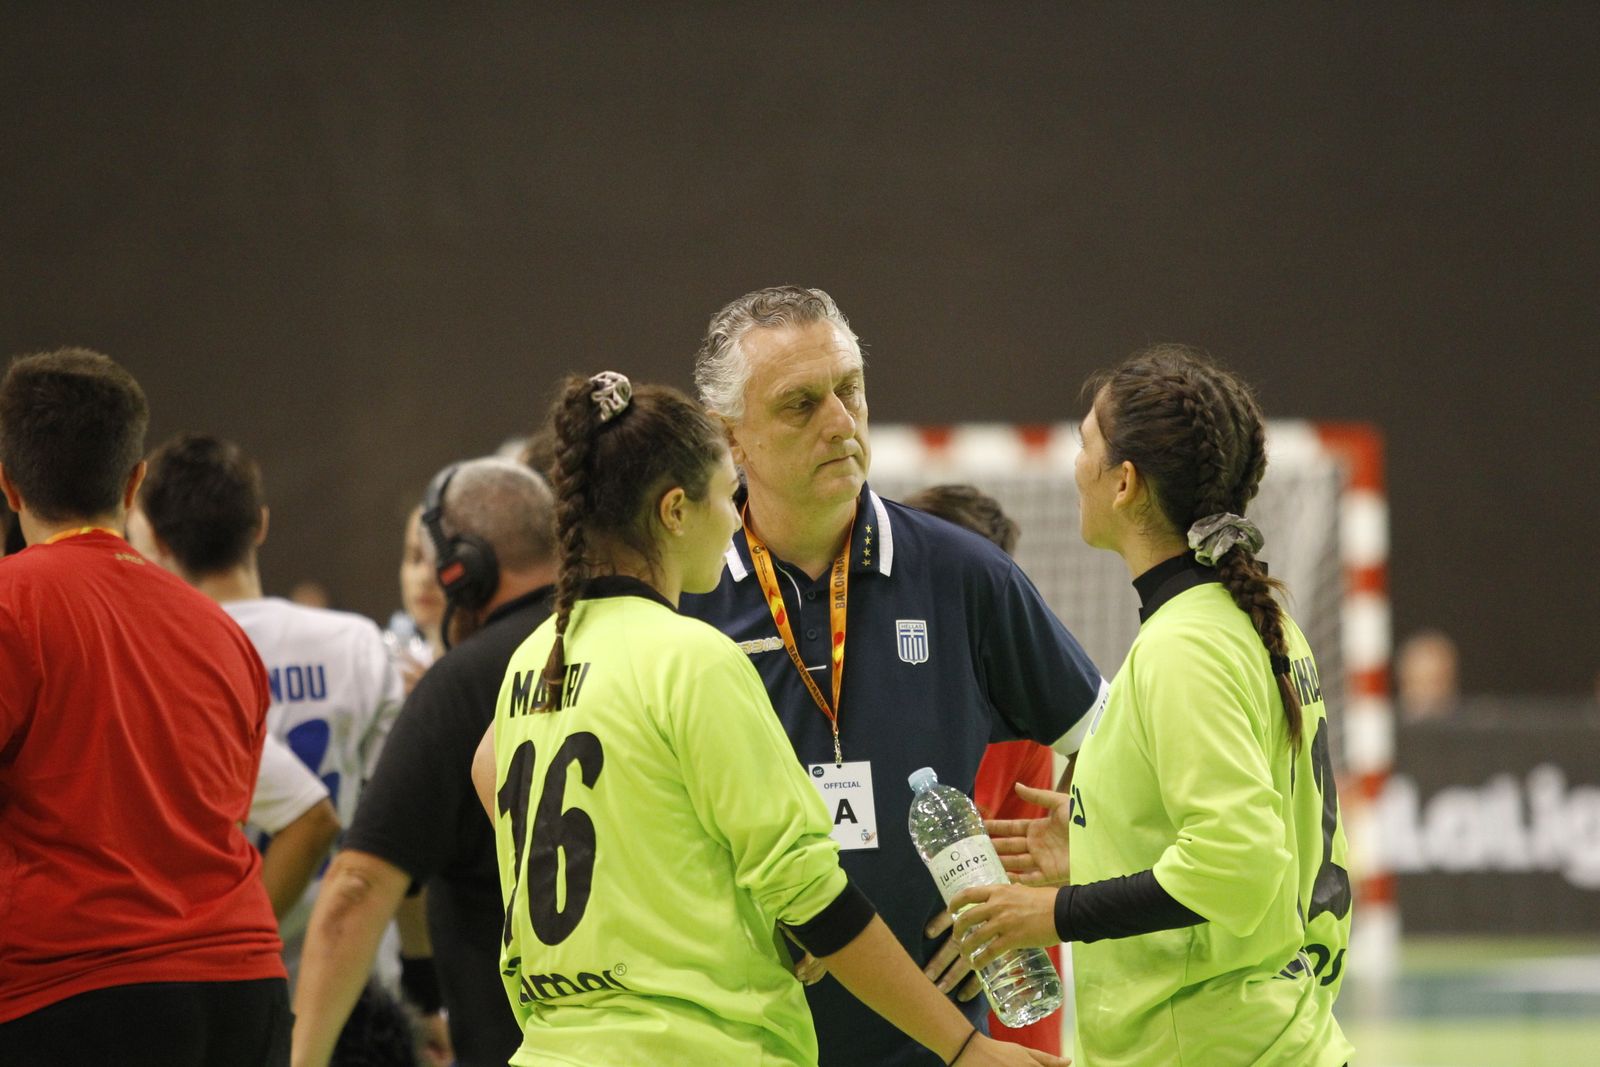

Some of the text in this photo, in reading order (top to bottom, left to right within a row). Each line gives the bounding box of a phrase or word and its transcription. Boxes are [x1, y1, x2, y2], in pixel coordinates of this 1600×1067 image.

[823, 781, 861, 790] OFFICIAL
[834, 798, 858, 825] A
[498, 731, 605, 948] 16
